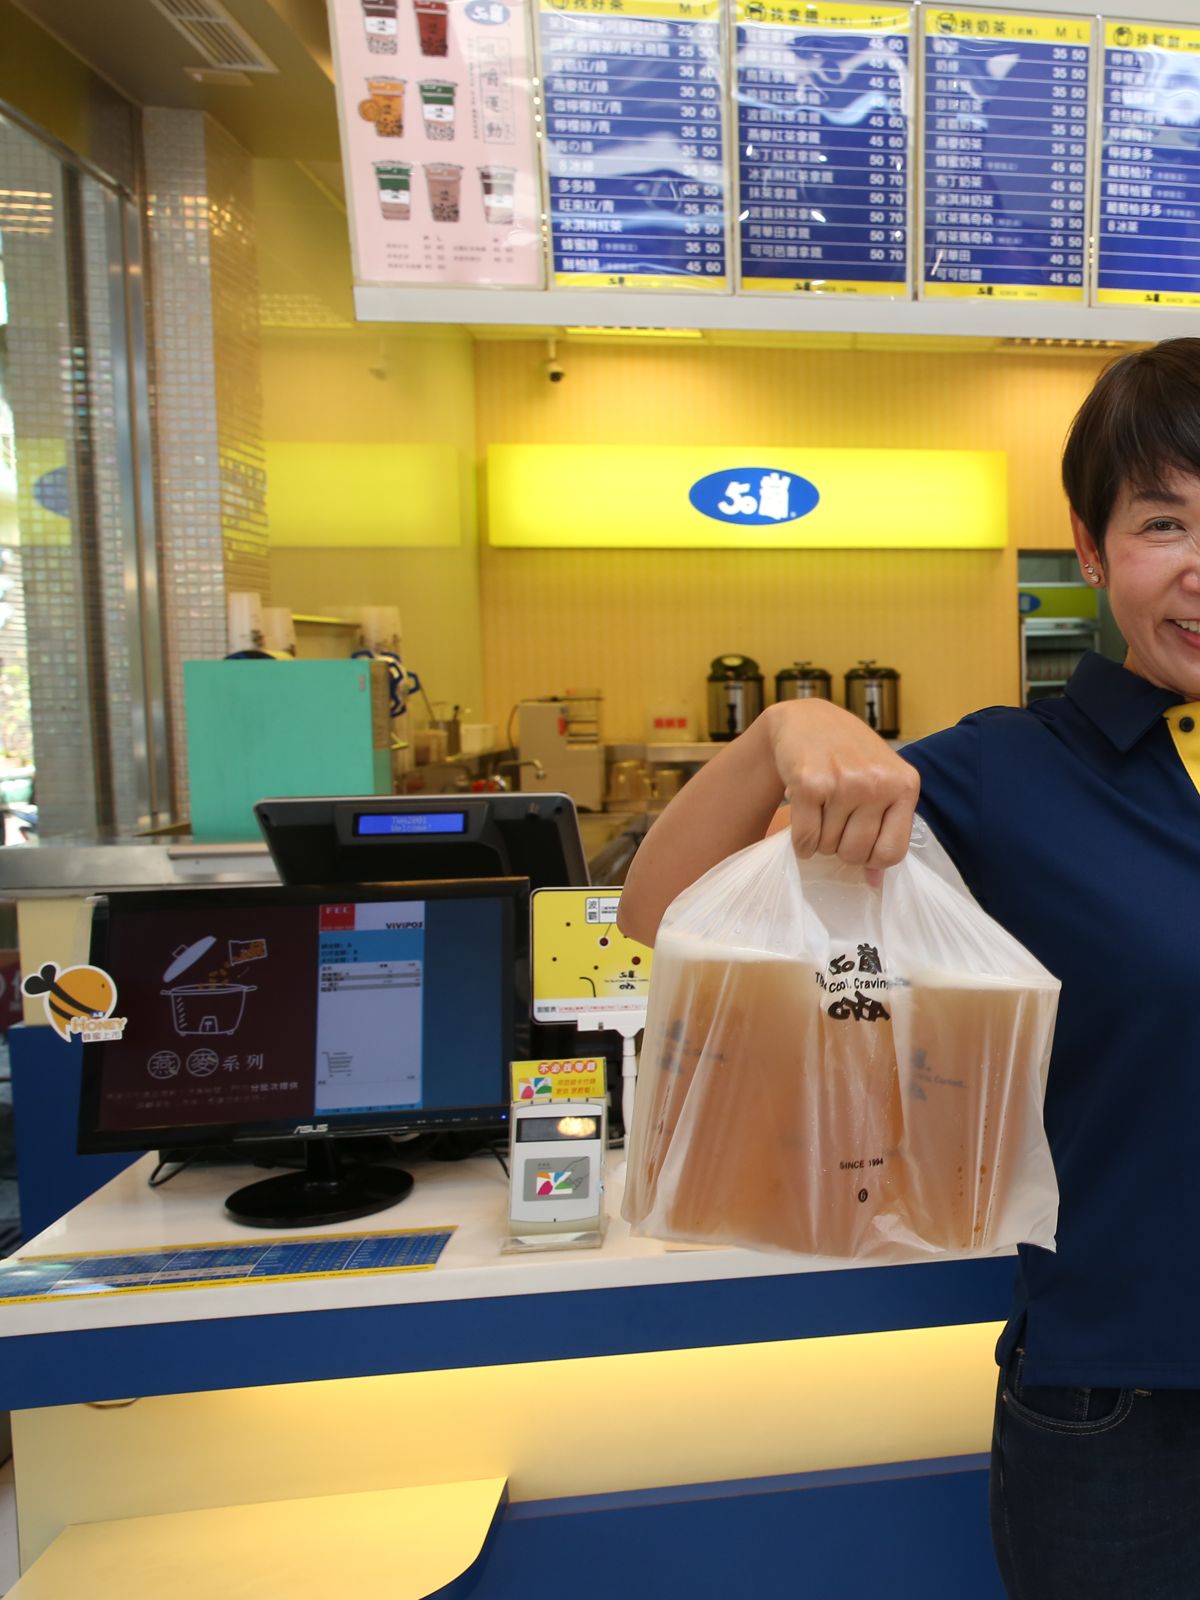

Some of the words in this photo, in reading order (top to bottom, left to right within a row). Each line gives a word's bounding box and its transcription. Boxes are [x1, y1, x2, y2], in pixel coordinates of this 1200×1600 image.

[1056, 28, 1066, 36] M
[1077, 29, 1082, 38] L
[869, 39, 883, 49] 45
[888, 39, 903, 50] 60
[679, 46, 694, 57] 25
[1053, 48, 1067, 59] 35
[1071, 49, 1086, 60] 50
[680, 66, 694, 77] 30
[699, 68, 714, 79] 40
[1053, 68, 1067, 78] 35
[1071, 69, 1086, 80] 50
[869, 77, 884, 88] 45
[680, 87, 695, 98] 30
[700, 88, 715, 98] 40
[1052, 87, 1067, 97] 35
[1071, 87, 1085, 99] 50
[681, 106, 696, 118] 30
[701, 108, 716, 118] 40
[1052, 106, 1066, 117] 35
[1071, 107, 1085, 118] 50
[869, 117, 884, 127] 45
[888, 117, 903, 128] 60
[681, 126, 697, 137] 35
[701, 128, 717, 138] 50
[1052, 125, 1066, 136] 35
[1070, 126, 1084, 136] 50
[869, 136, 884, 146] 45
[889, 137, 903, 148] 60
[682, 145, 697, 156] 35
[702, 147, 717, 157] 50
[1052, 144, 1065, 154] 35
[1070, 145, 1084, 155] 50
[869, 155, 884, 165] 50
[703, 166, 718, 176] 50
[1051, 162, 1065, 173] 45
[1070, 163, 1083, 173] 60
[870, 174, 884, 185] 50
[889, 175, 903, 185] 70
[704, 185, 718, 196] 50
[1051, 181, 1065, 192] 45
[1069, 182, 1083, 192] 60
[870, 193, 884, 203] 50
[889, 194, 903, 204] 70
[684, 204, 699, 215] 35
[704, 205, 719, 215] 50
[1051, 200, 1064, 210] 45
[1069, 200, 1083, 211] 60
[870, 212, 884, 222] 50
[890, 213, 903, 223] 70
[685, 223, 700, 234] 35
[705, 224, 719, 235] 50
[1050, 218, 1064, 228] 35
[1069, 218, 1082, 229] 50
[870, 231, 884, 241] 50
[1050, 236, 1064, 246] 35
[1069, 236, 1082, 247] 50
[686, 242, 700, 253] 35
[706, 243, 720, 254] 50
[870, 249, 884, 260] 50
[890, 250, 903, 260] 70
[1050, 254, 1063, 265] 40
[1068, 255, 1081, 265] 55
[687, 261, 701, 272] 45
[706, 262, 721, 272] 60
[1050, 273, 1063, 283] 45
[1068, 273, 1081, 284] 60
[294, 1124, 328, 1134] ASUS
[840, 1160, 864, 1170] SINCE
